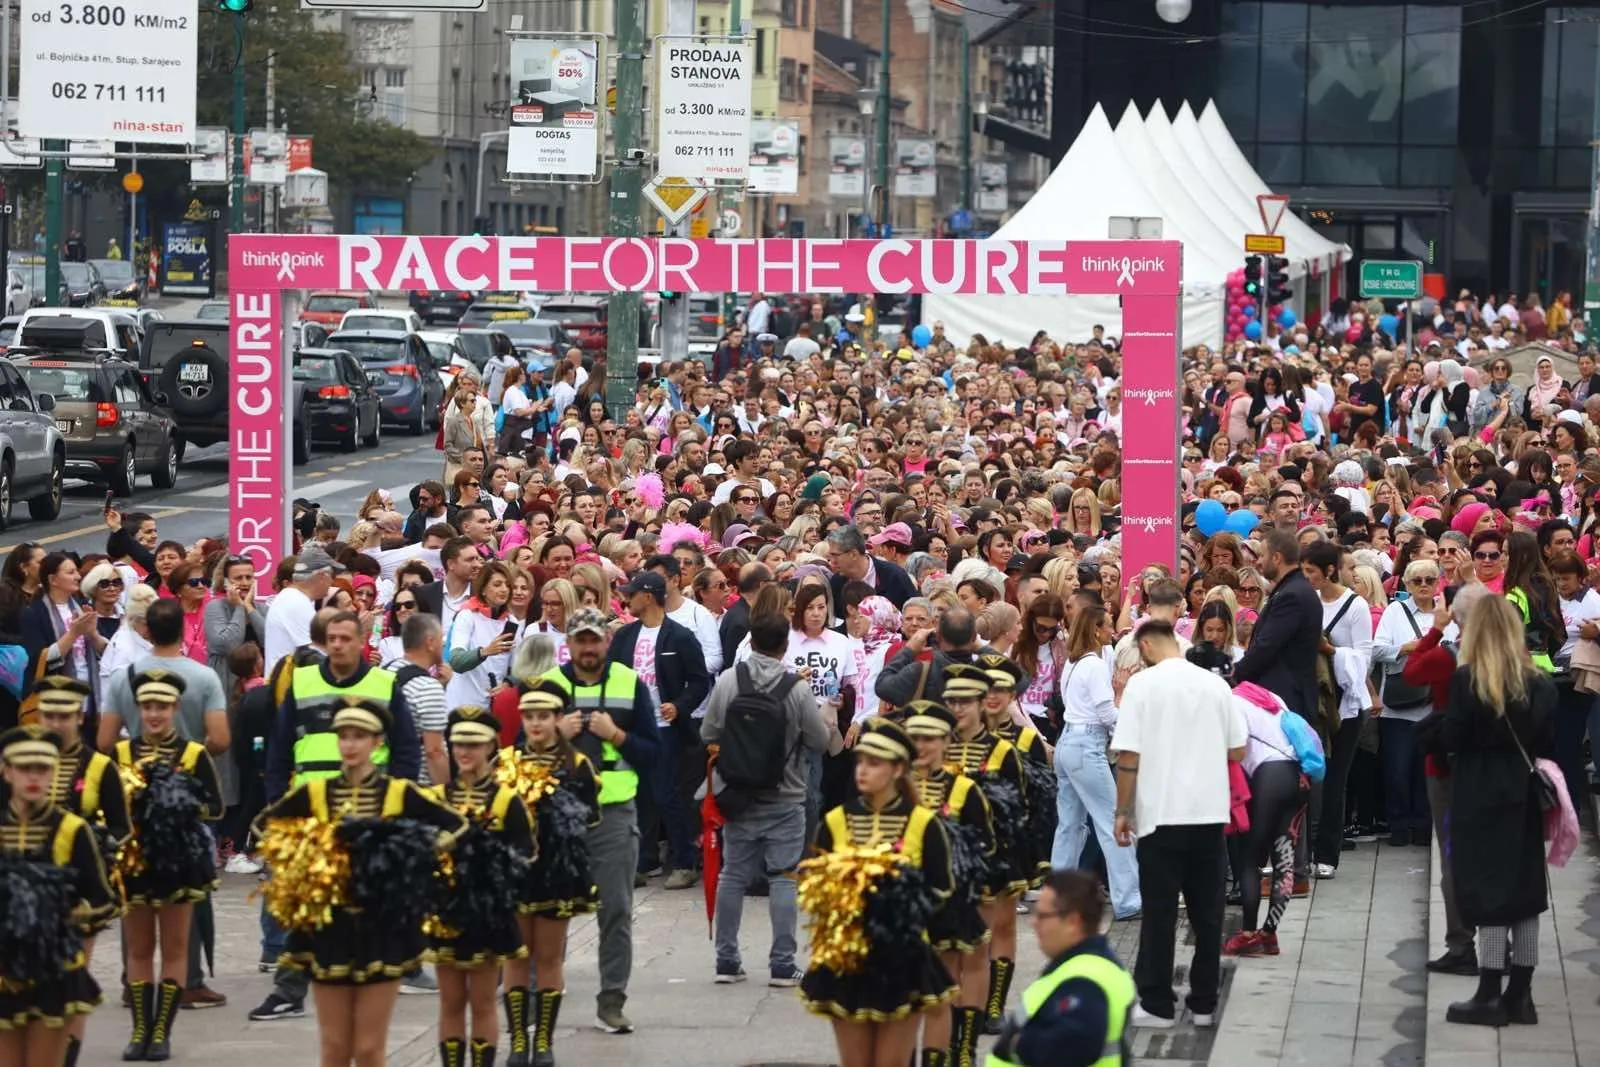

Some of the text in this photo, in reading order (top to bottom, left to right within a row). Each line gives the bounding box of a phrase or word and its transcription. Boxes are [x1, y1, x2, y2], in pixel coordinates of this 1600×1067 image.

[31, 4, 188, 30] od 3.800 KM/m2
[142, 57, 181, 67] Sarajevo
[670, 48, 742, 63] PRODAJA
[558, 68, 583, 78] 50%
[670, 66, 741, 80] STANOVA
[52, 81, 165, 103] 062 711 111
[664, 103, 746, 117] od 3.300 KM/m2
[113, 118, 184, 133] nina-stan
[675, 145, 734, 157] 062 711 111
[339, 236, 1068, 294] RACE FOR THE CURE
[236, 293, 273, 416] CURE
[237, 429, 273, 508] THE
